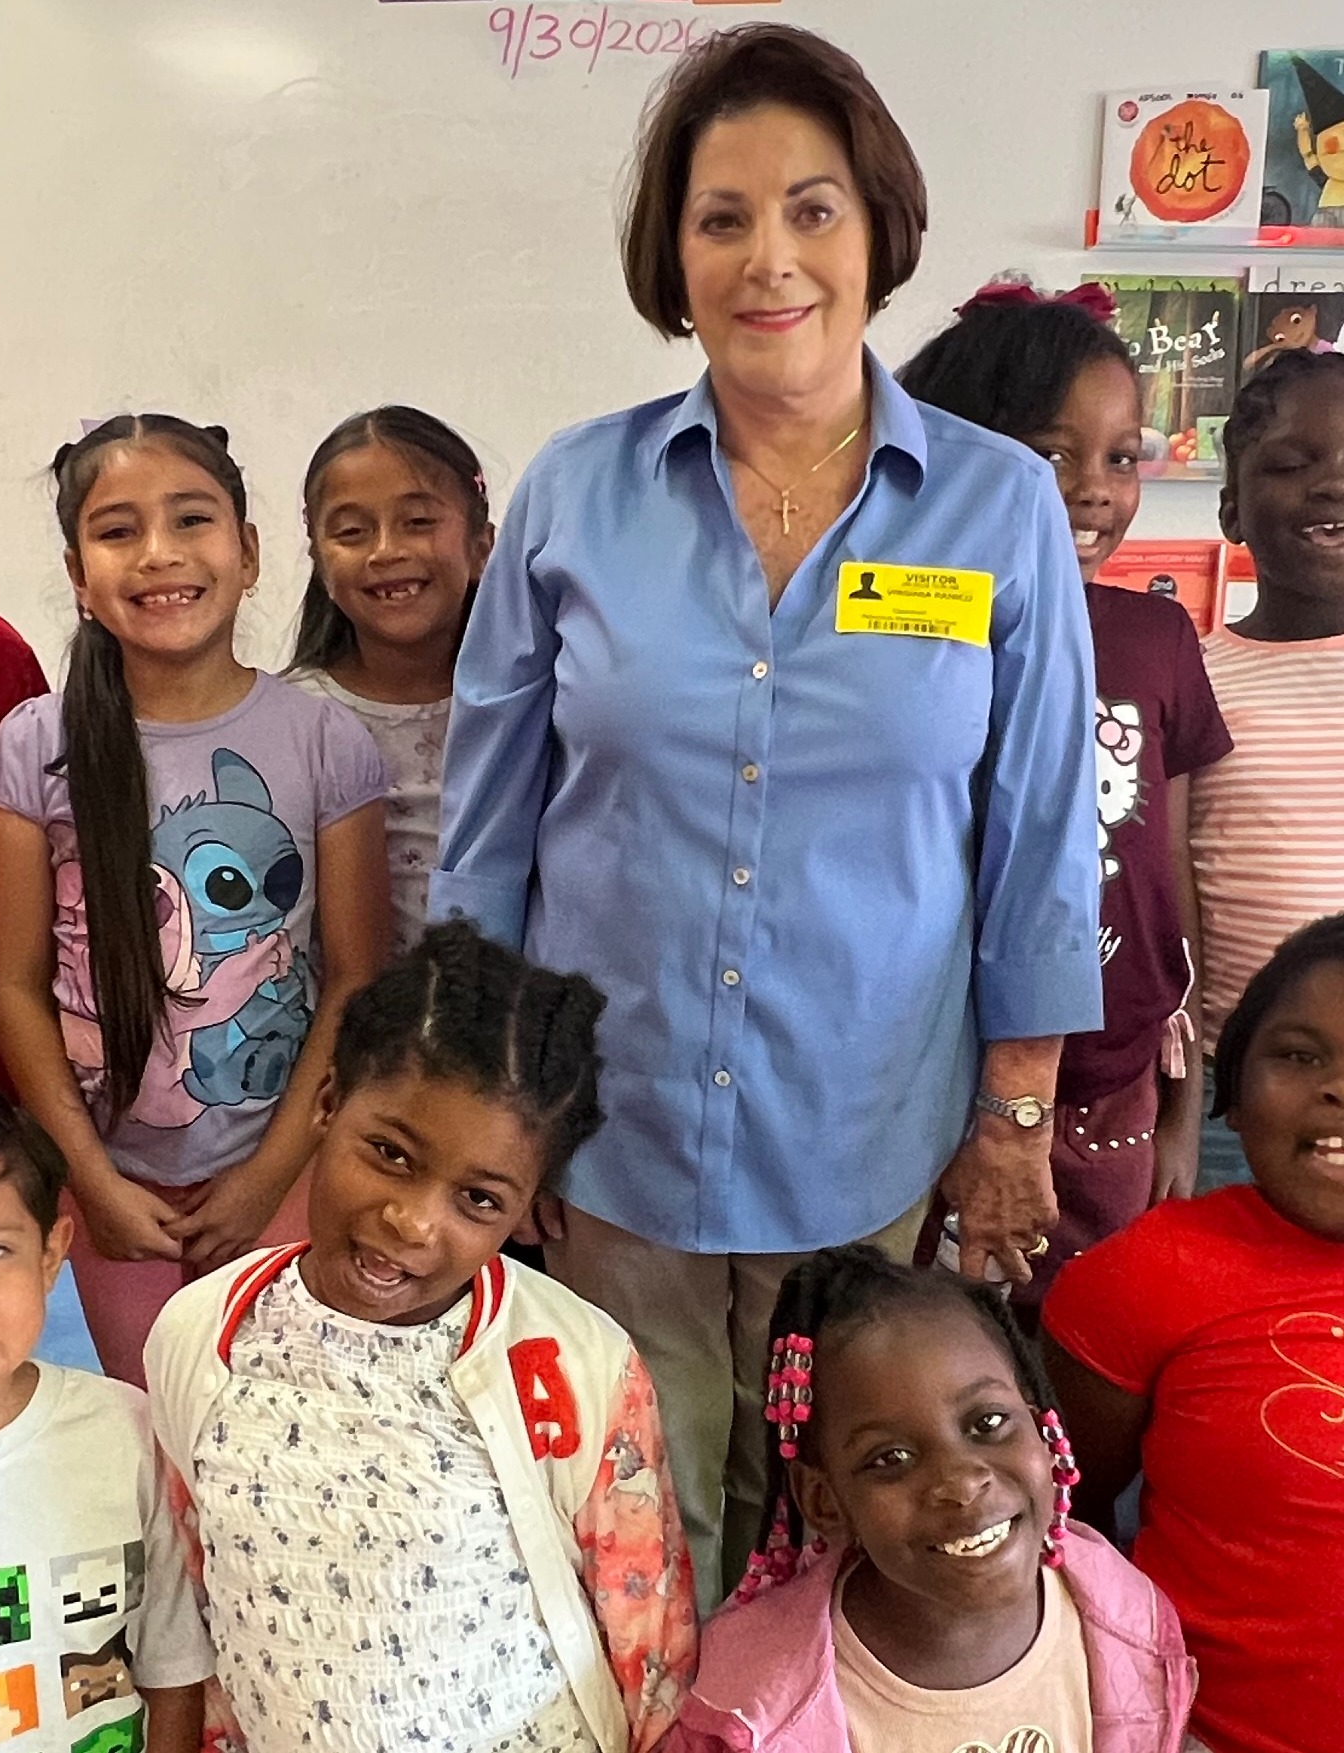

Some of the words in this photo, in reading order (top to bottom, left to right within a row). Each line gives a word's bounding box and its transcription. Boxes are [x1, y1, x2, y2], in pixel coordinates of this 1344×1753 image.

[1168, 120, 1215, 154] the
[1156, 156, 1226, 194] dot
[1147, 310, 1222, 355] Bear
[905, 573, 957, 584] VISITOR
[507, 1337, 583, 1462] A
